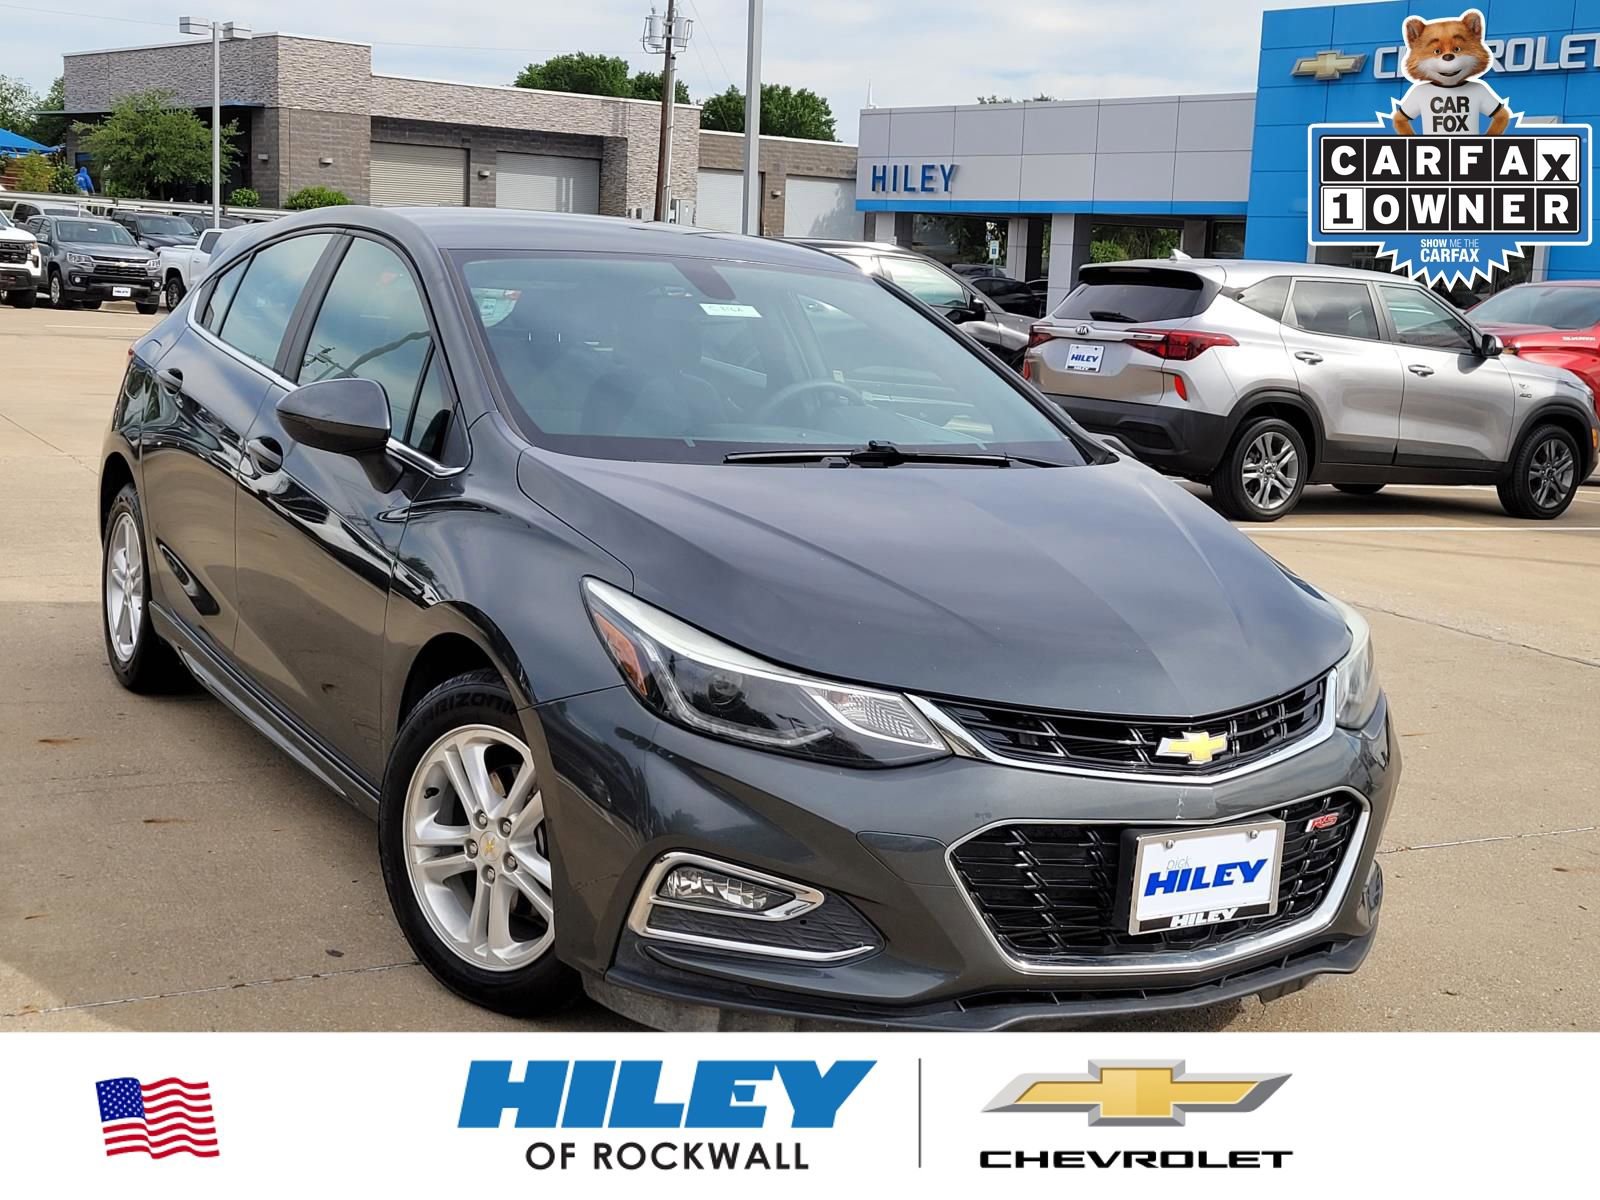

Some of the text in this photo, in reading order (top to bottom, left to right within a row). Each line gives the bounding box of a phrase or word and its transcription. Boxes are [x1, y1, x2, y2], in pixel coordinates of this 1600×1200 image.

[871, 163, 955, 193] HILEY
[1070, 353, 1099, 363] HILEY
[1144, 858, 1269, 897] HILEY
[1170, 907, 1239, 928] HILEY
